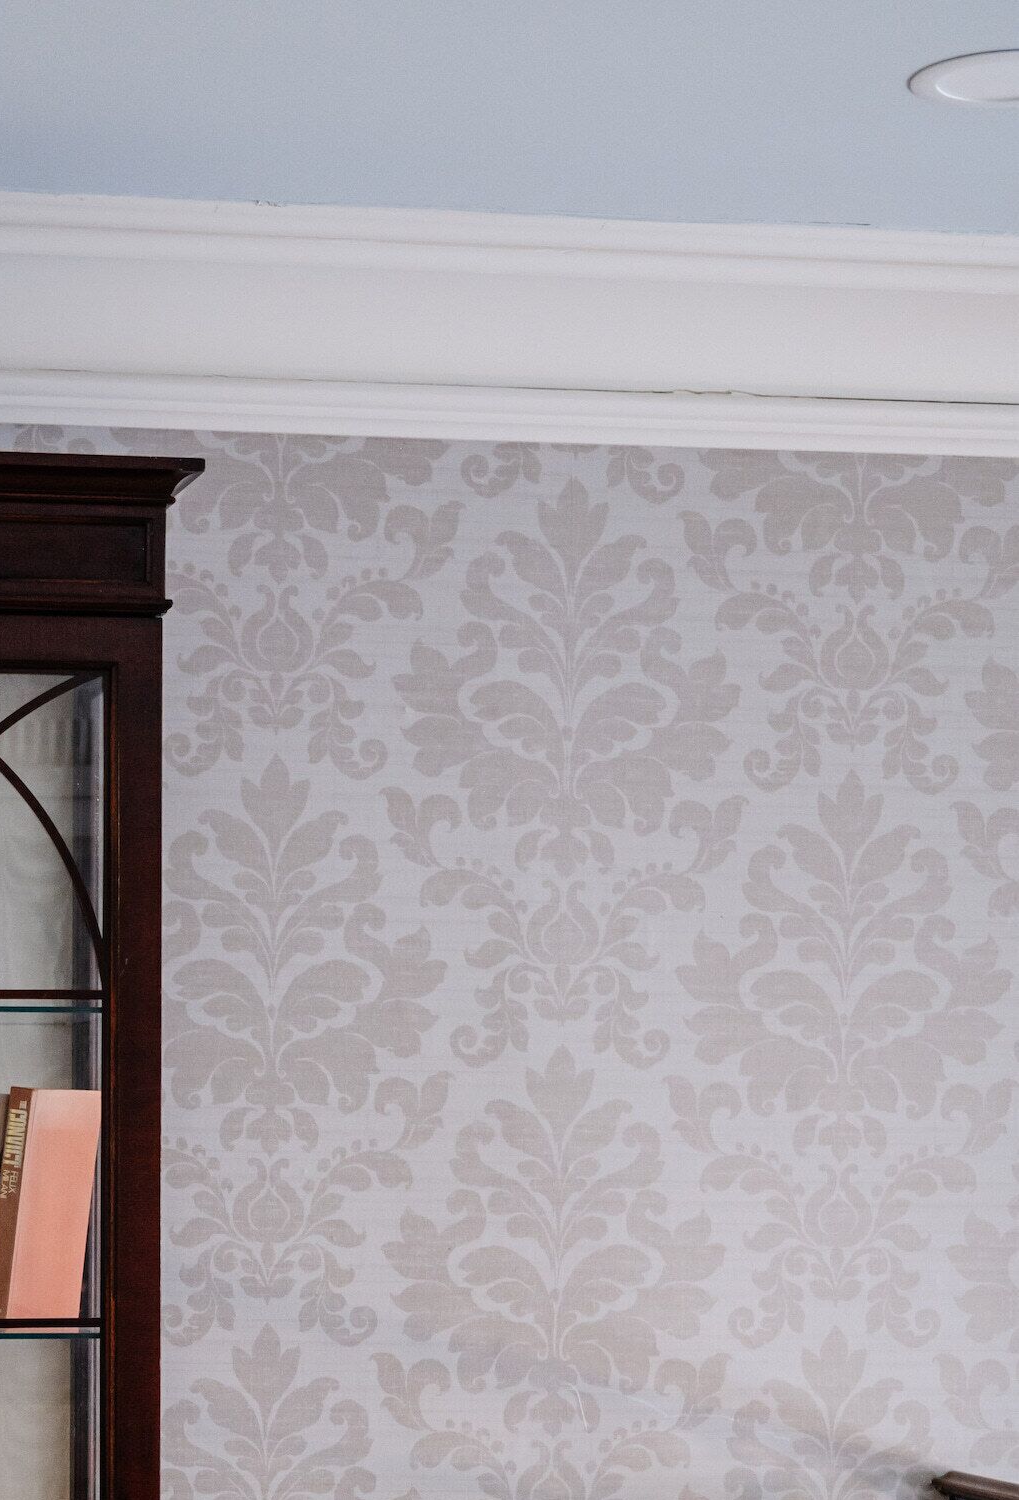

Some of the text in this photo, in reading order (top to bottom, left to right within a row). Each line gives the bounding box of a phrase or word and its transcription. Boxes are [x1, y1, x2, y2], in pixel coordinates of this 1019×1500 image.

[2, 1108, 28, 1169] CONVICT
[0, 1169, 10, 1199] MILANI
[8, 1170, 19, 1194] FELIX
